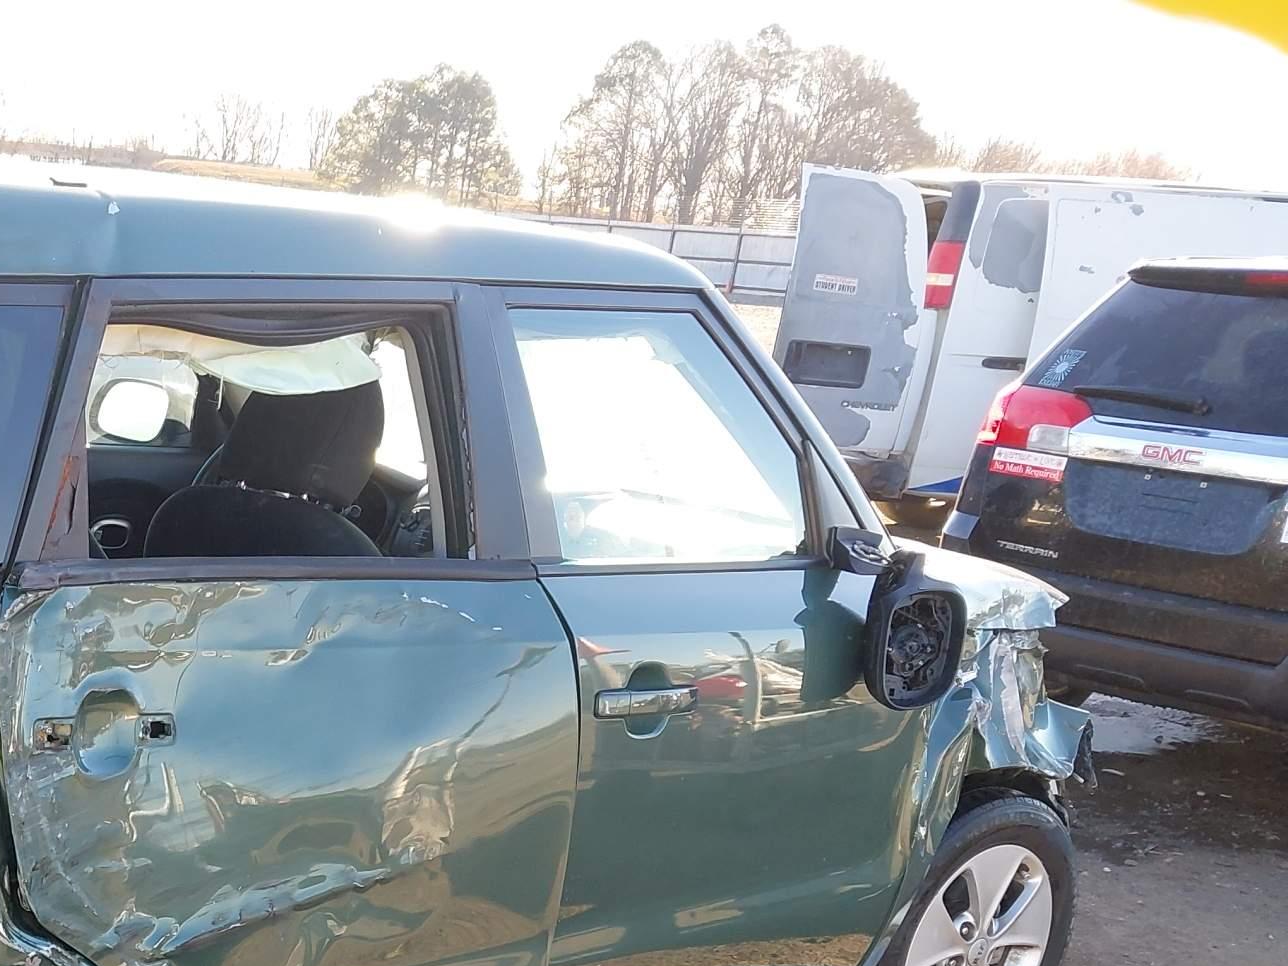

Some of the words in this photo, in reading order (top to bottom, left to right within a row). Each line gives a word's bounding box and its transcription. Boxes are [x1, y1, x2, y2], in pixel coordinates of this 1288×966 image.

[1142, 445, 1206, 465] GMC
[994, 461, 1004, 470] No
[1005, 463, 1024, 473] Math
